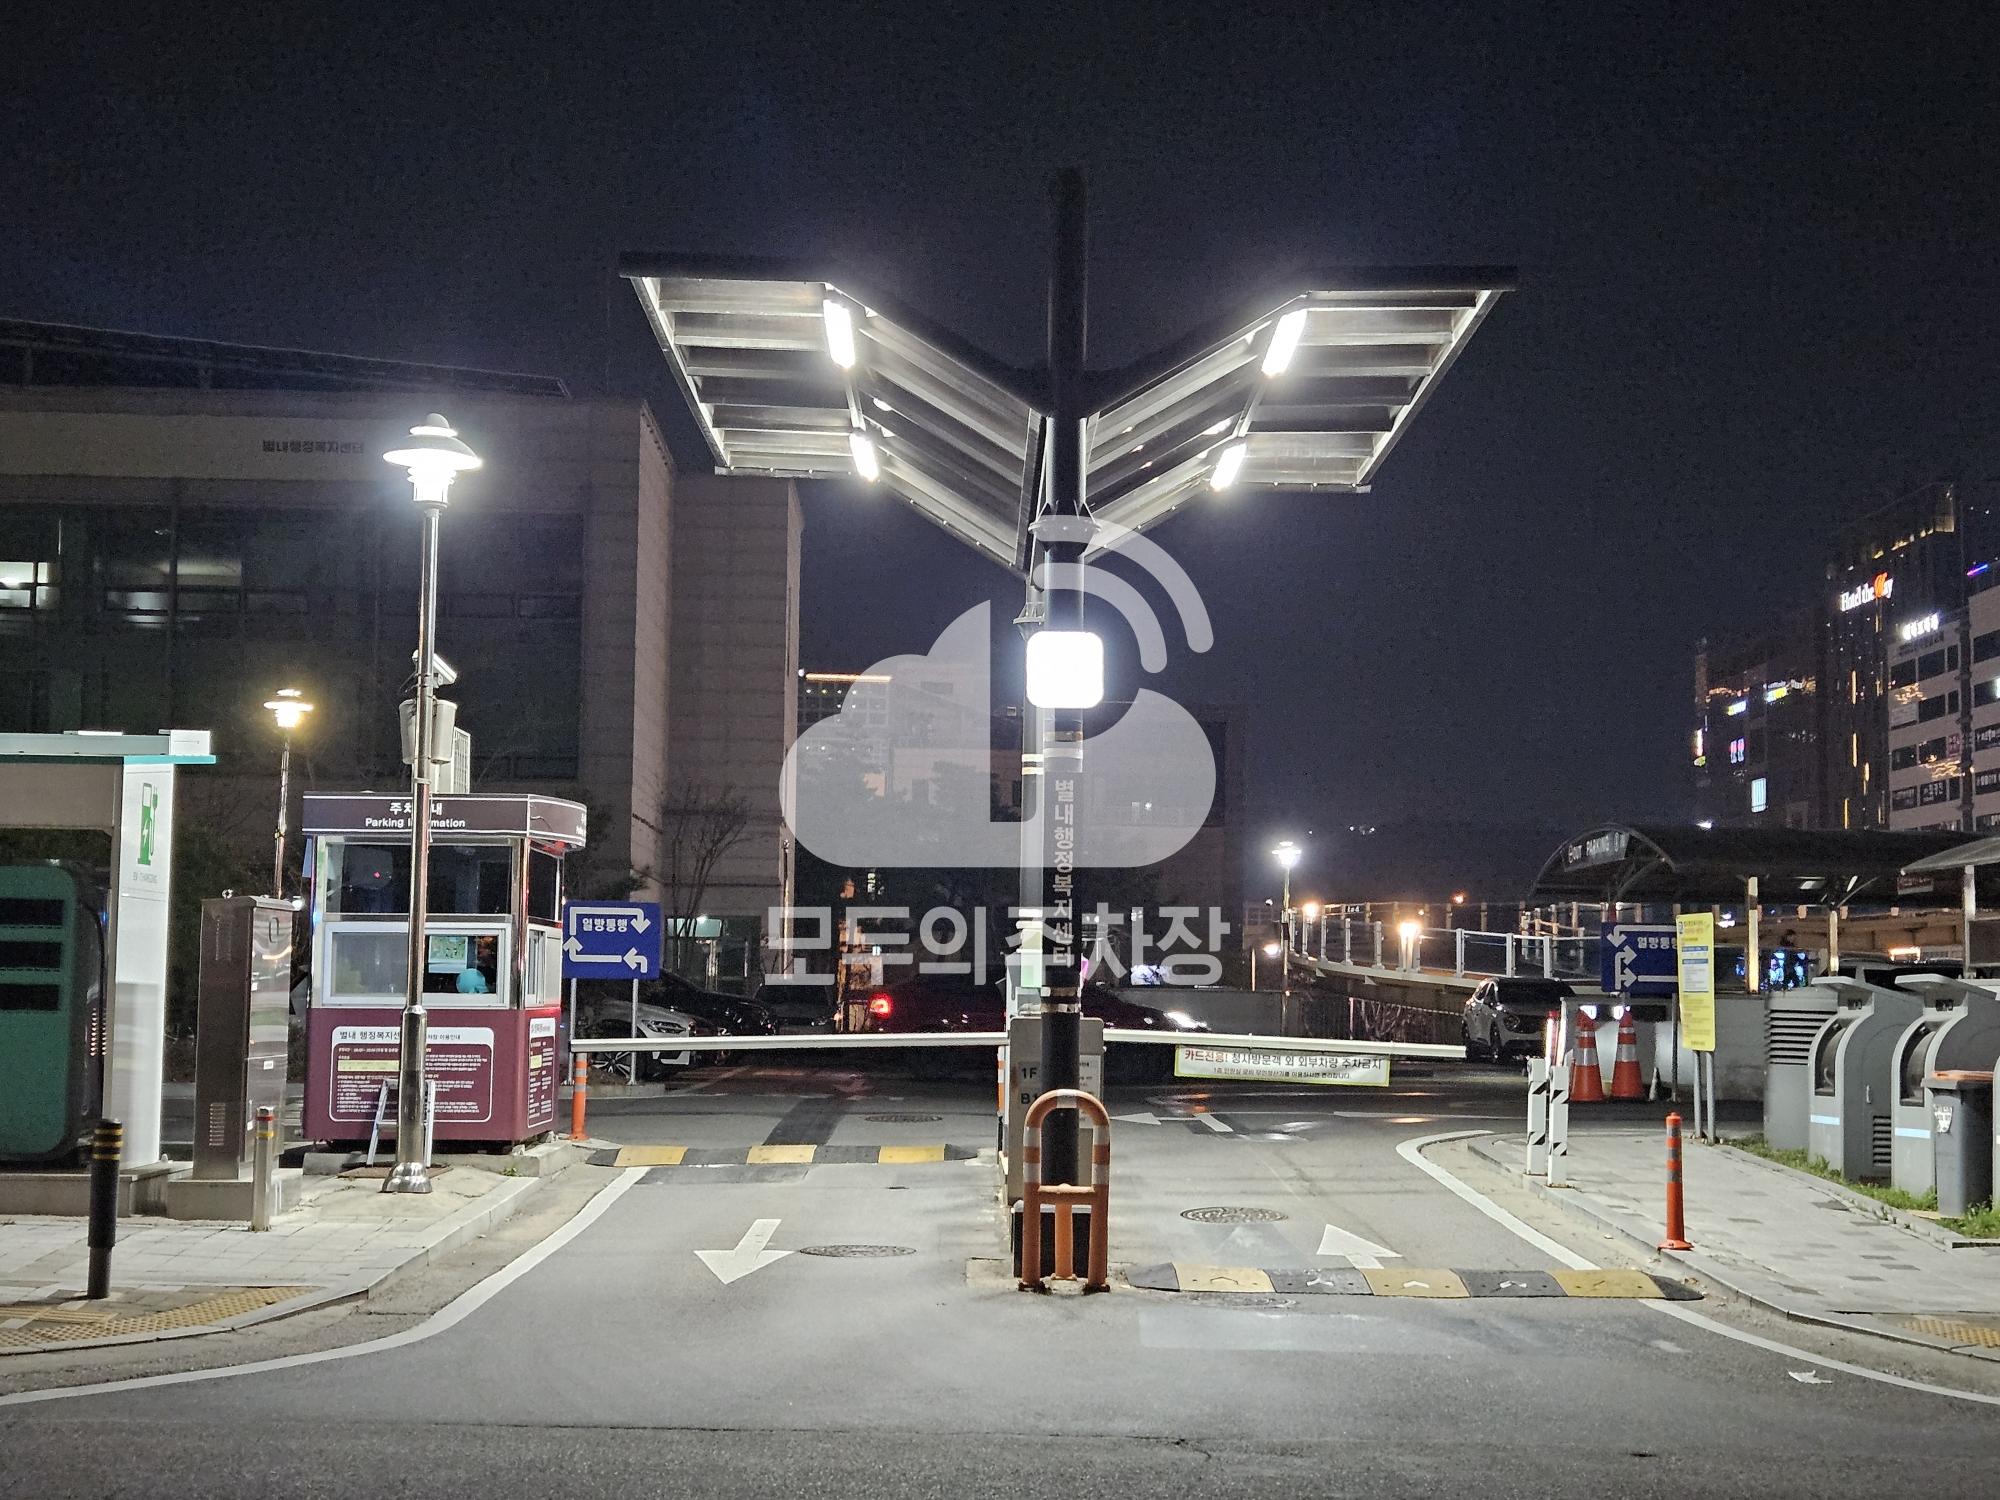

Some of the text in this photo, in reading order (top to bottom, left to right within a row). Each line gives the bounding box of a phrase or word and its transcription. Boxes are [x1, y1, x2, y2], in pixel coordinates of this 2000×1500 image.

[365, 817, 404, 829] Parking
[1052, 779, 1074, 968] 별내행정복지센터
[1285, 1055, 1295, 1067] 외
[1298, 1056, 1338, 1069] 외부차량
[1341, 1058, 1382, 1071] 주차금지
[1021, 1066, 1037, 1079] 1F
